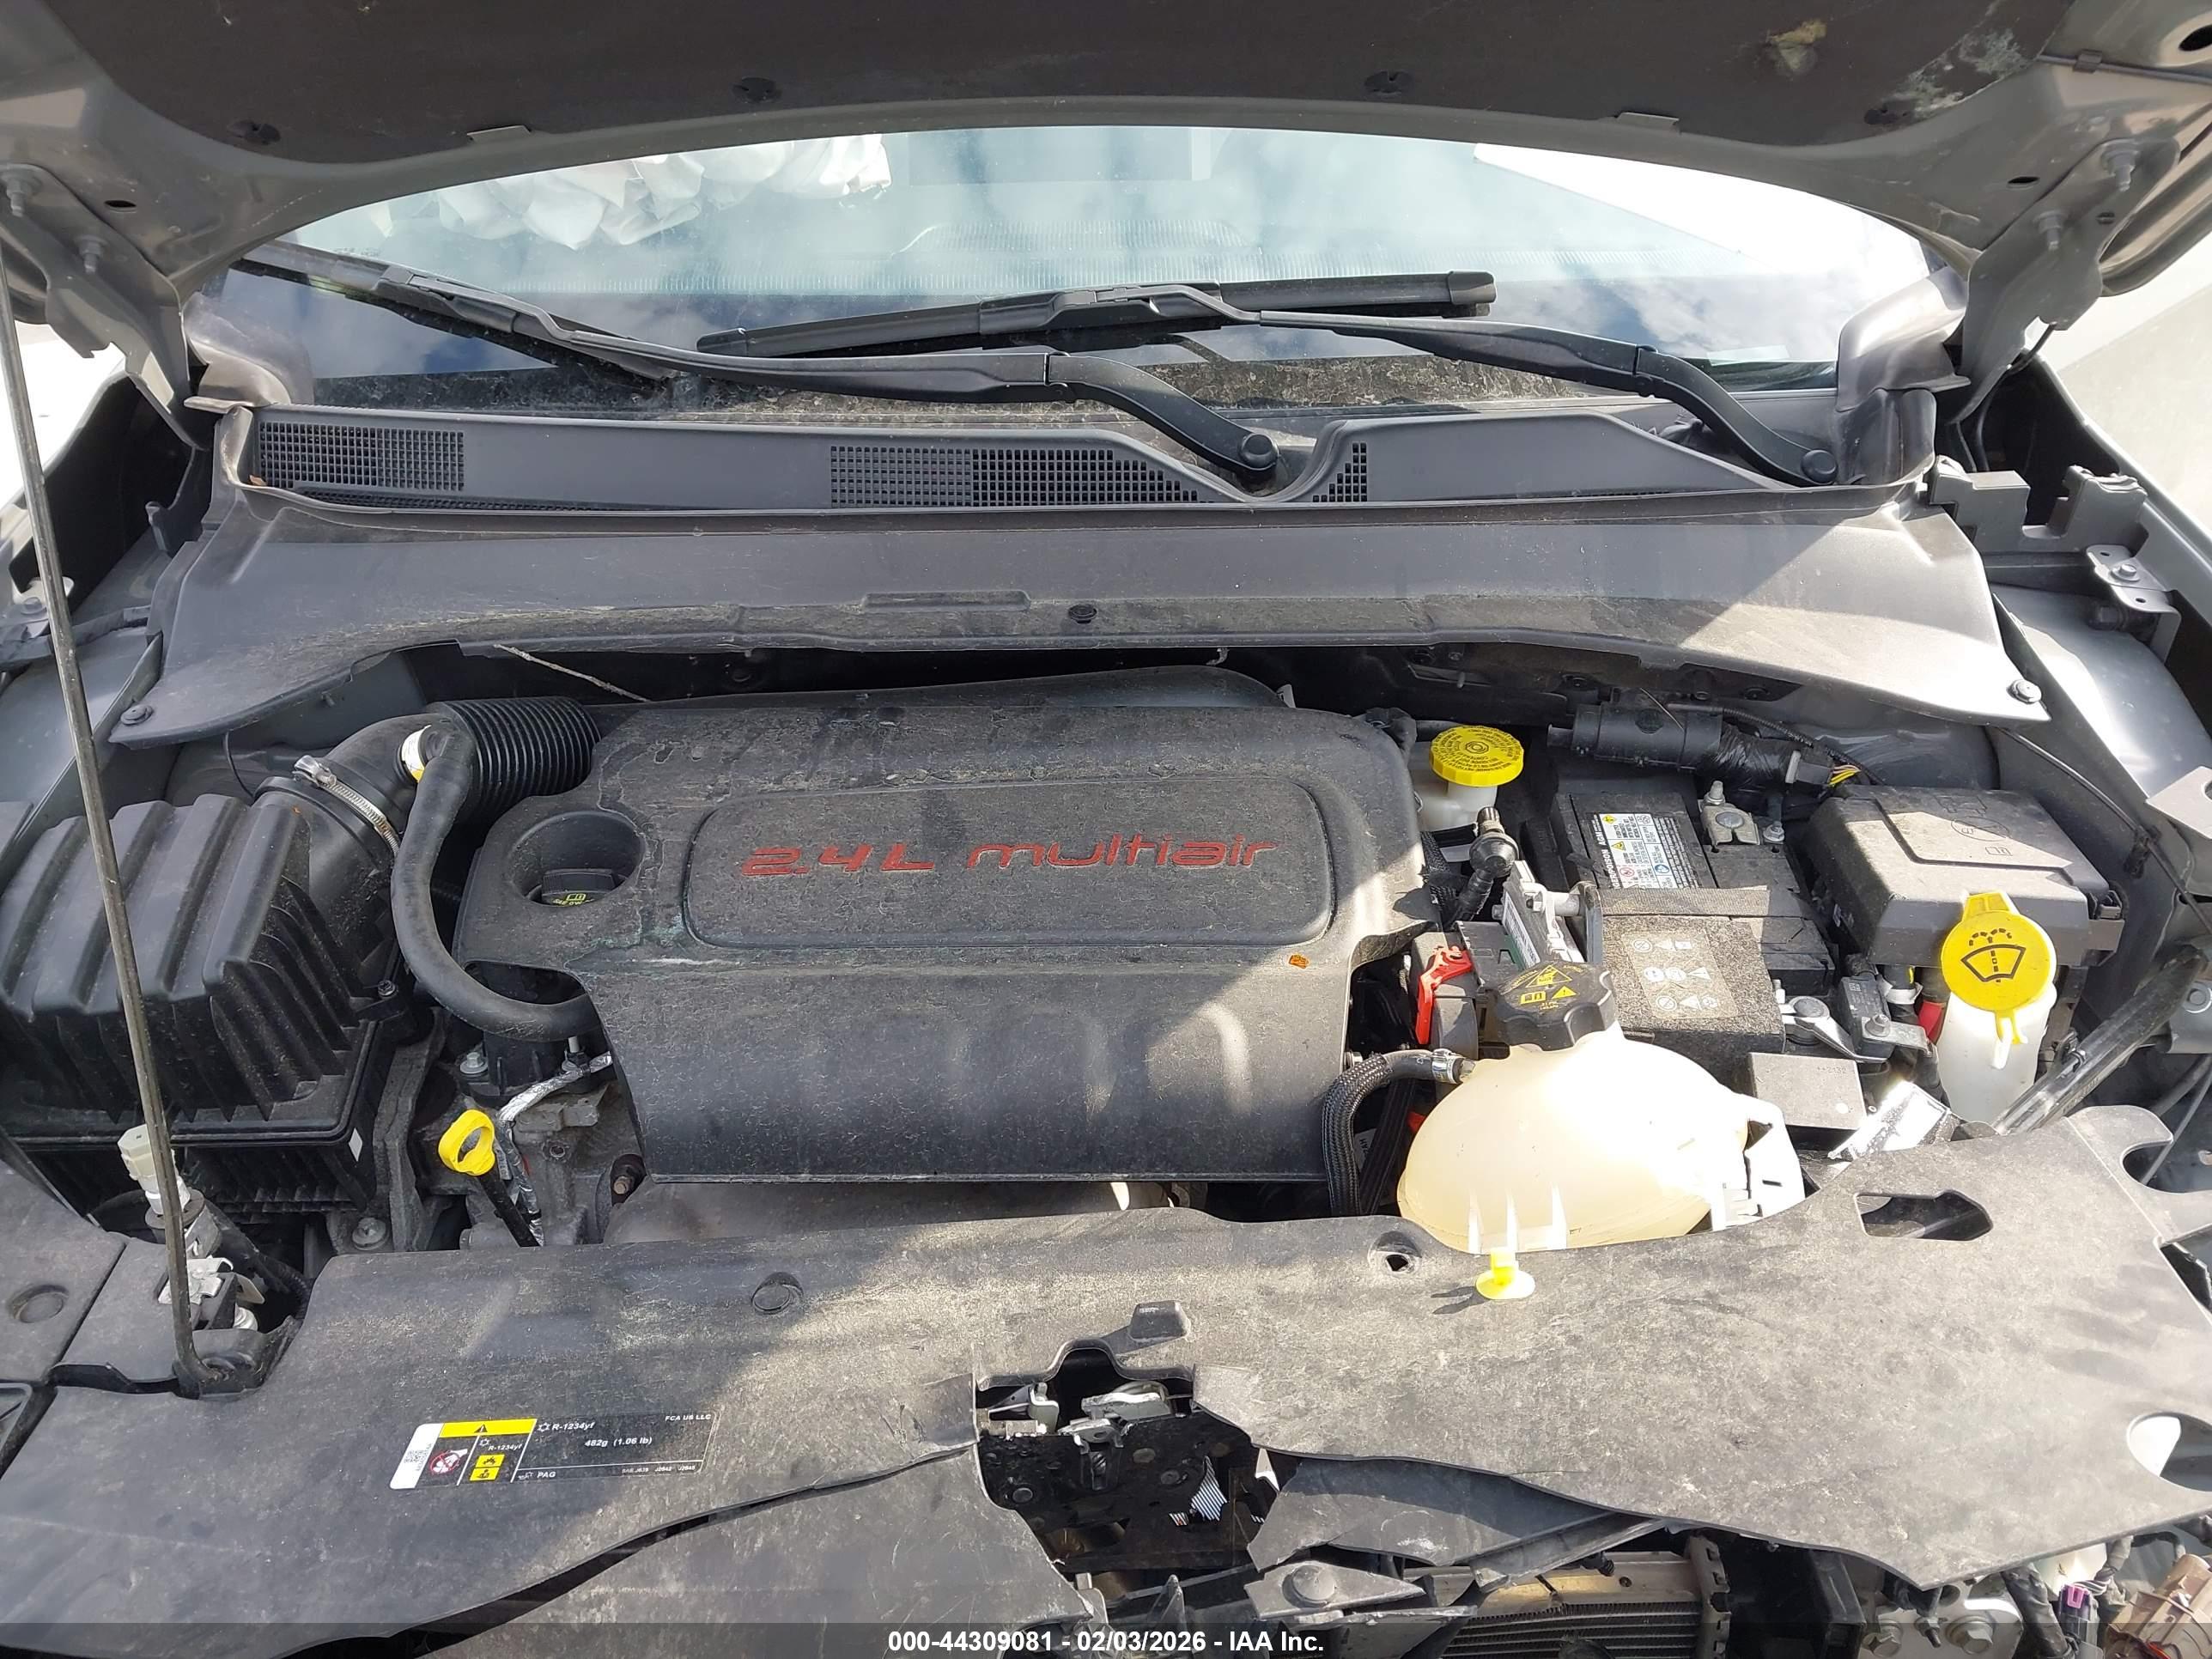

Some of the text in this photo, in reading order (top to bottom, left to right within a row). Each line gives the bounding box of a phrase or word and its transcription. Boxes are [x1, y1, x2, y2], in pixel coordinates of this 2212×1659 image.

[1595, 830, 1607, 846] AGM
[968, 833, 1278, 869] multiair
[551, 1421, 596, 1431] R-1234yf
[488, 1443, 523, 1451] R-1234yf
[584, 1436, 653, 1448] 482g (1.06 lb)
